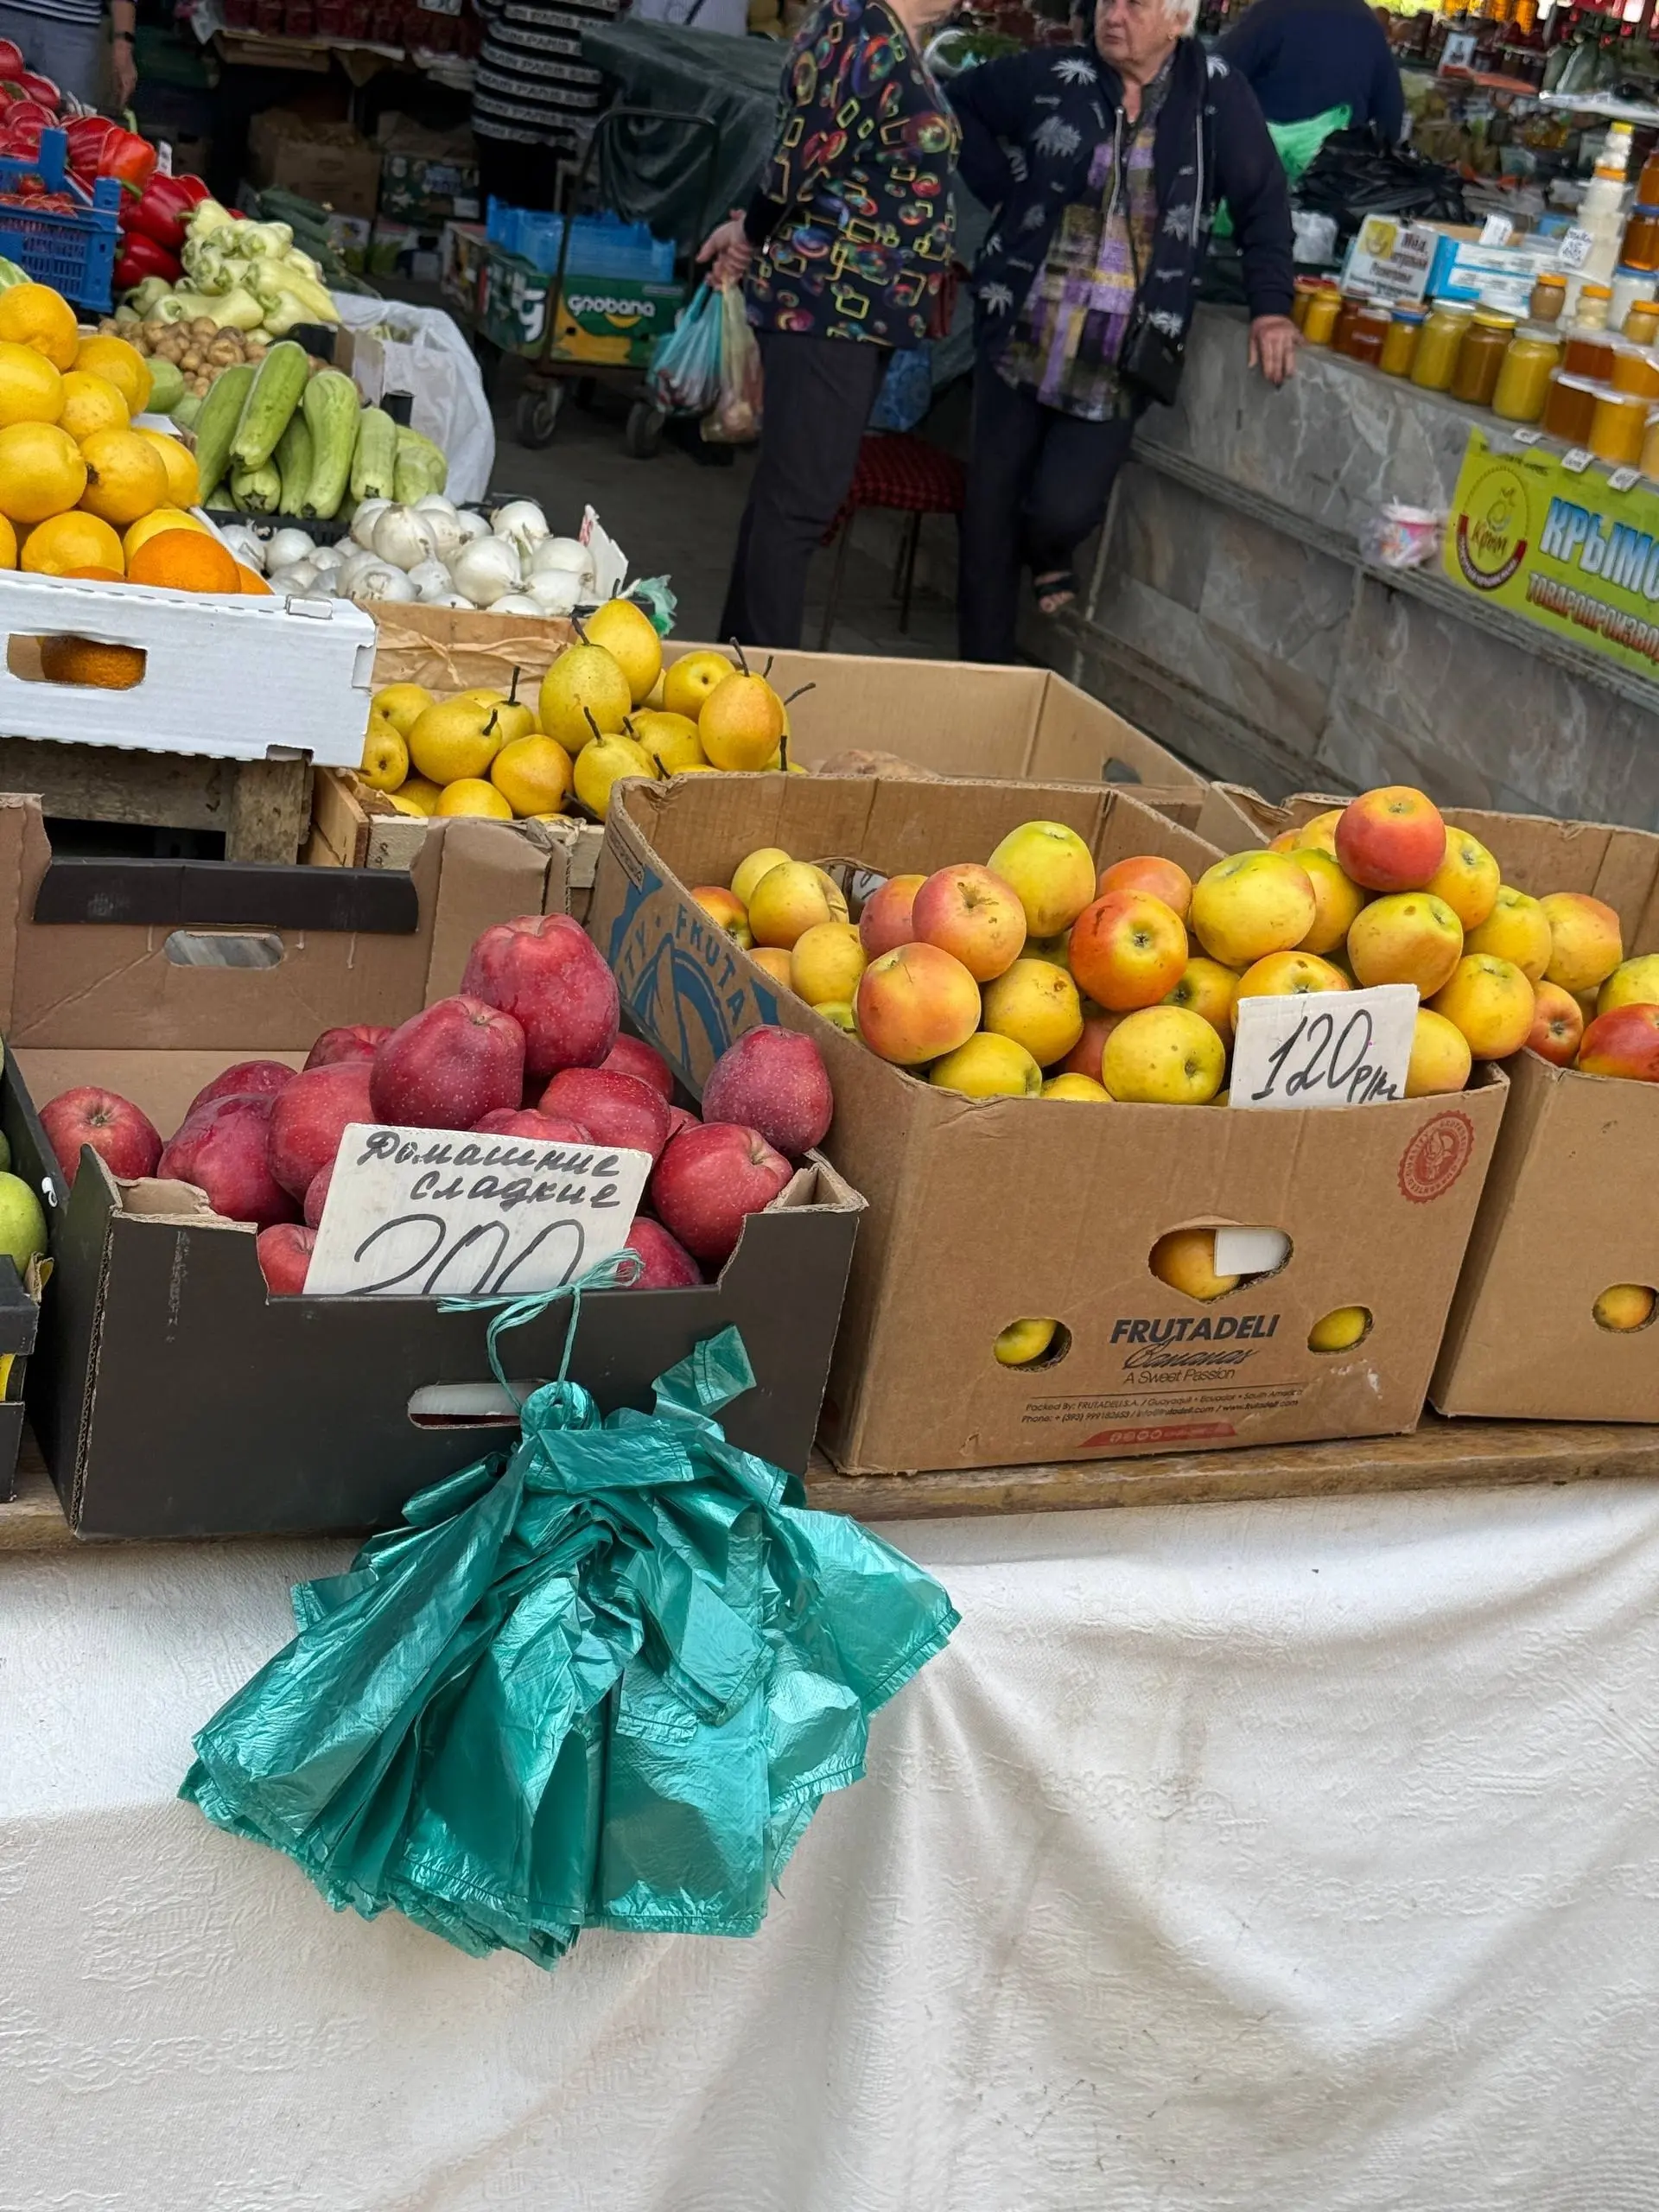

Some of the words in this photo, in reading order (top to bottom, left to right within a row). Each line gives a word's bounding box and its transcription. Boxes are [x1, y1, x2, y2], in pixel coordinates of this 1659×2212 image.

[675, 903, 745, 1026] FRUTA
[356, 1130, 621, 1178] Домашние
[347, 1213, 585, 1295] 200
[1109, 1313, 1281, 1344] FRUTADELI
[1122, 1371, 1135, 1384] A
[1138, 1370, 1183, 1384] Sweet
[1183, 1366, 1236, 1382] Passion
[1021, 1415, 1052, 1424] Phone:
[1026, 1402, 1061, 1412] Packed
[1062, 1401, 1076, 1413] By:
[1077, 1399, 1122, 1410] FRUTADELI
